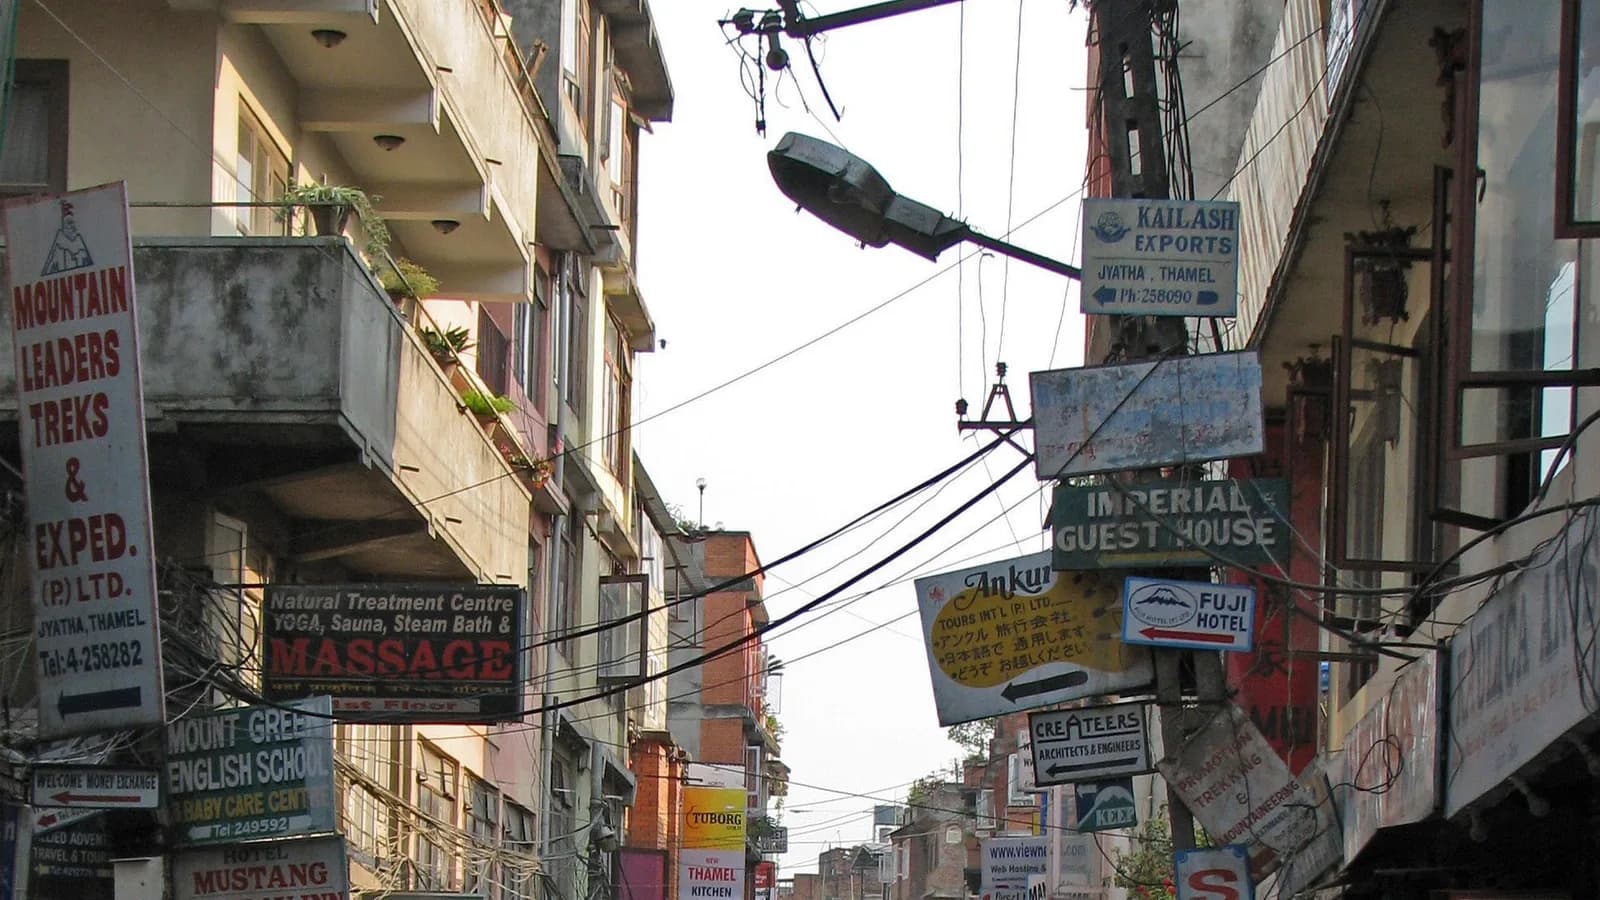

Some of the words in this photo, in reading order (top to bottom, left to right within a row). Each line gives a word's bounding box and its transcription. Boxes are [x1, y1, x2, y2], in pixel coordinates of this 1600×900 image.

[1137, 206, 1235, 230] KAILASH
[1135, 235, 1232, 254] EXPORTS
[13, 266, 127, 330] MOUNTAIN
[21, 329, 120, 392] LEADERS
[29, 392, 109, 448] TREKS
[65, 457, 88, 502] &
[1087, 485, 1251, 517] IMPERIAL
[35, 512, 137, 570] EXPED.
[1056, 522, 1161, 552] GUEST
[1177, 517, 1276, 548] HOUSE
[76, 572, 132, 602] LTD.
[271, 592, 340, 611] Natural
[347, 593, 444, 611] Treatment
[451, 594, 513, 612] Centre
[1200, 593, 1246, 612] FUJI
[274, 614, 325, 635] YOGA,
[331, 614, 387, 635] Sauna,
[394, 614, 447, 633] Steam
[453, 616, 492, 633] Bath
[499, 616, 510, 633] &
[939, 615, 976, 631] TOURS
[1197, 613, 1247, 632] HOTEL
[940, 631, 988, 650] アンクル
[270, 637, 513, 680] MASSAGE
[958, 664, 992, 681] どうぞ
[383, 700, 458, 710] Floor
[167, 713, 240, 755] MOUNT
[1035, 712, 1140, 738] CREATEERS
[1039, 746, 1089, 761] ARCHITECTS
[1097, 740, 1141, 754] ENGINEERS
[36, 774, 82, 789] WELCOME
[86, 774, 114, 789] MONEY
[117, 775, 157, 790] EXCHANGE
[168, 752, 250, 794] ENGLISH
[1194, 752, 1263, 808] TREKKING
[184, 797, 222, 822] BABY
[225, 792, 264, 817] CARE
[214, 824, 231, 837] Tel
[235, 817, 288, 835] 249592
[692, 811, 742, 826] TUBORG
[34, 847, 70, 862] TRAVEL
[224, 847, 288, 864] HOTEL
[192, 862, 328, 895] MUSTANG
[688, 867, 736, 882] THAMEL
[691, 886, 732, 898] KITCHEN
